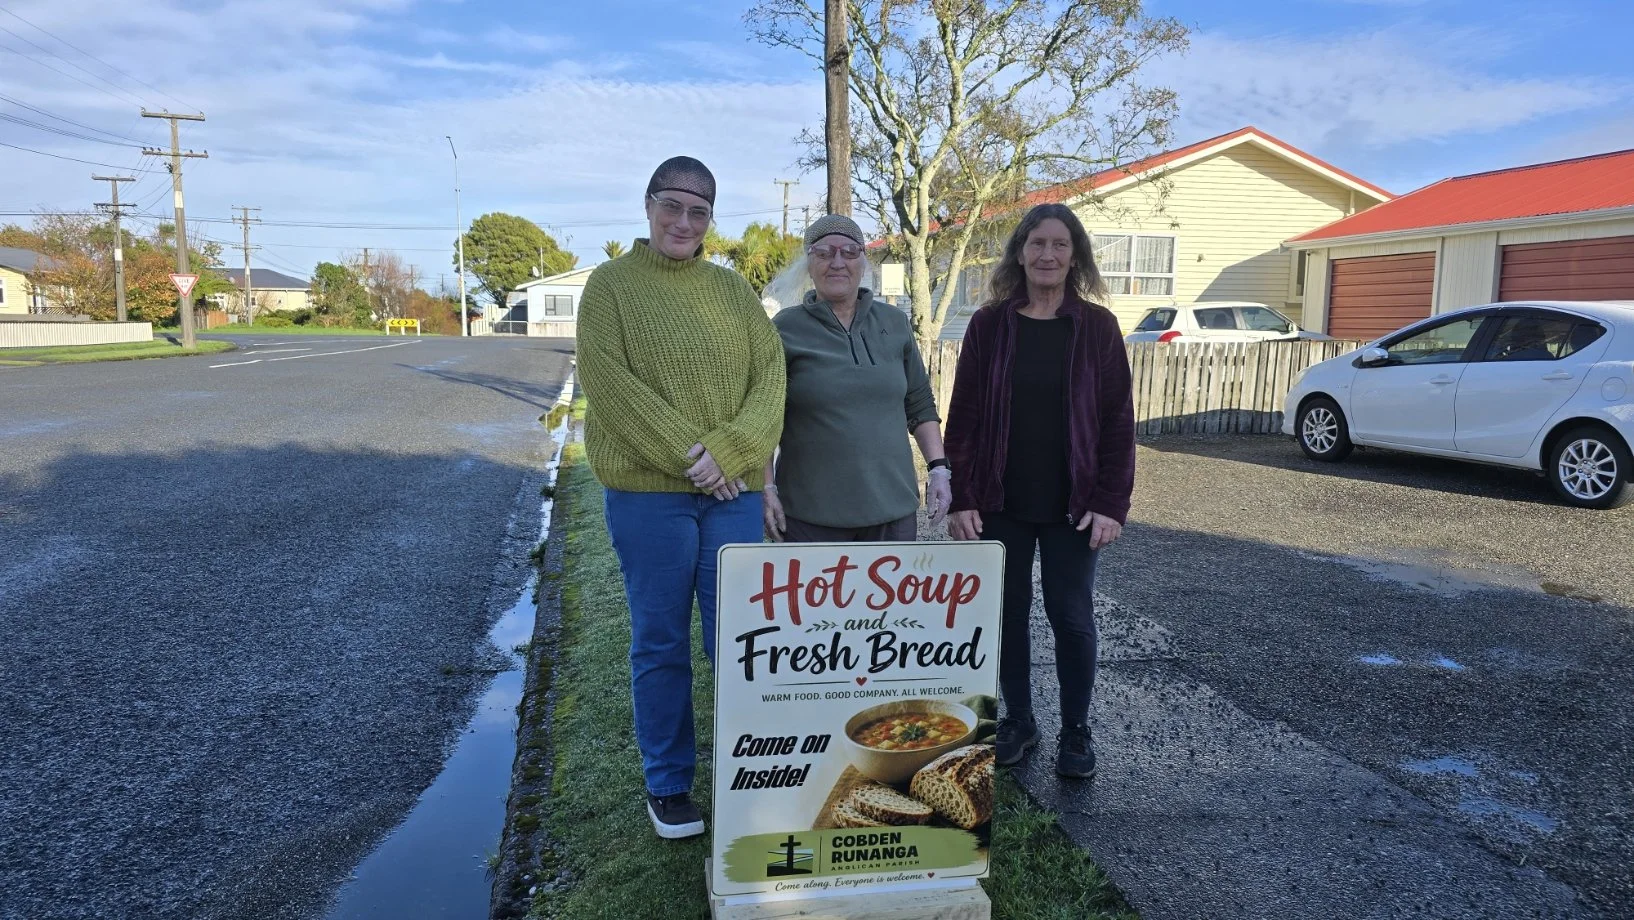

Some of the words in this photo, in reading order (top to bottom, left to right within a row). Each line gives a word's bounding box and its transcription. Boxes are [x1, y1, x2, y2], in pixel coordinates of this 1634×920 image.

[749, 555, 858, 626] Hot
[866, 555, 981, 629] Soup
[844, 611, 888, 631] and
[735, 625, 860, 682] Fresh
[866, 626, 986, 674] Bread
[761, 693, 791, 703] WARM
[794, 691, 822, 701] FOOD.
[824, 690, 851, 700] GOOD
[853, 688, 899, 699] COMPANY.
[901, 688, 917, 697] ALL
[919, 686, 965, 696] WELCOME.
[731, 733, 796, 758] Come
[800, 733, 832, 754] on
[729, 763, 812, 791] Inside!
[831, 832, 902, 849] COBDEN
[831, 845, 919, 864] RUNANGA
[830, 863, 881, 872] ANGLICAN
[885, 859, 920, 867] PARISH
[775, 882, 801, 892] Come
[803, 880, 832, 892] along.
[834, 875, 874, 889] Everyone
[886, 872, 925, 882] welcome.
